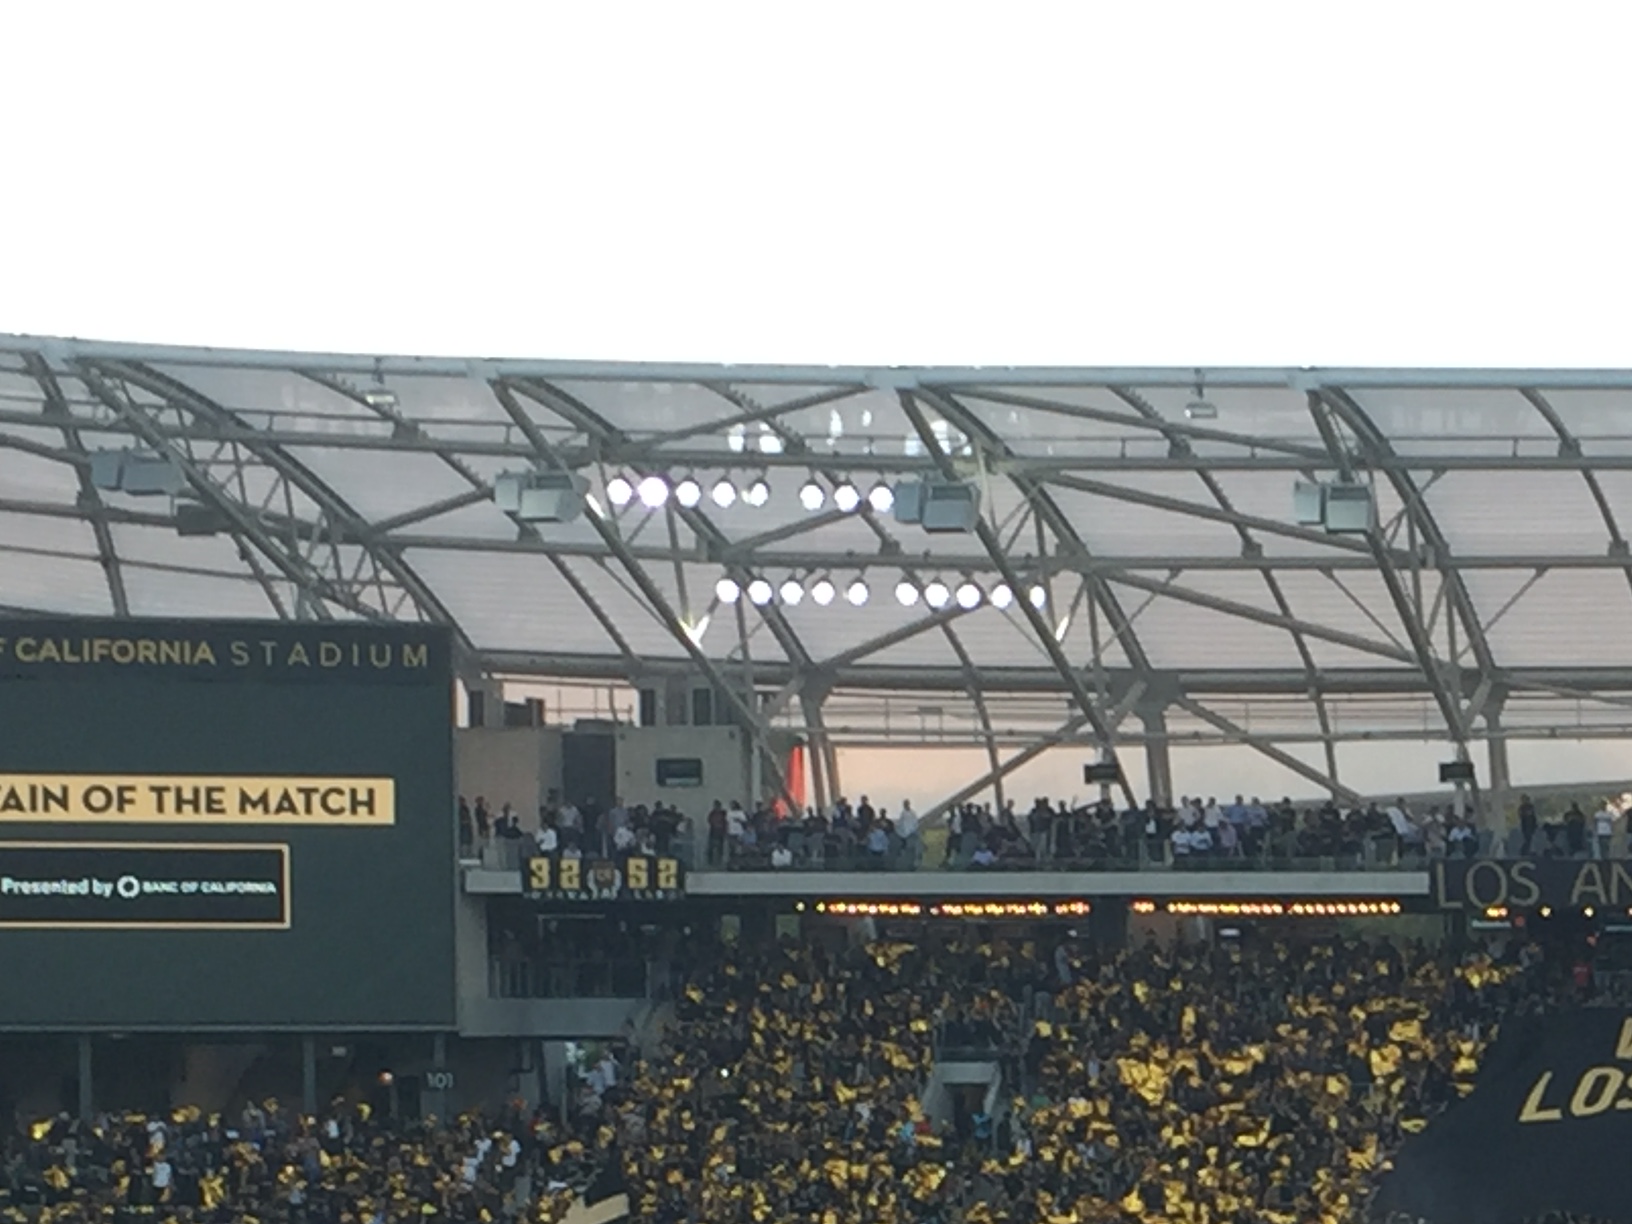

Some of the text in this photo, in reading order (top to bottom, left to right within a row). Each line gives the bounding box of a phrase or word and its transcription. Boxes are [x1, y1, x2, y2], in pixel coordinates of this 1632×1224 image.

[15, 637, 217, 666] CALIFORNIA
[230, 641, 429, 668] STADIUM
[0, 784, 376, 816] AIN OF THE MATCH
[1, 877, 89, 895] Presented
[92, 878, 114, 898] by
[180, 881, 198, 894] OF
[201, 881, 277, 894] CALIFORNIA
[1435, 861, 1541, 909] LOS
